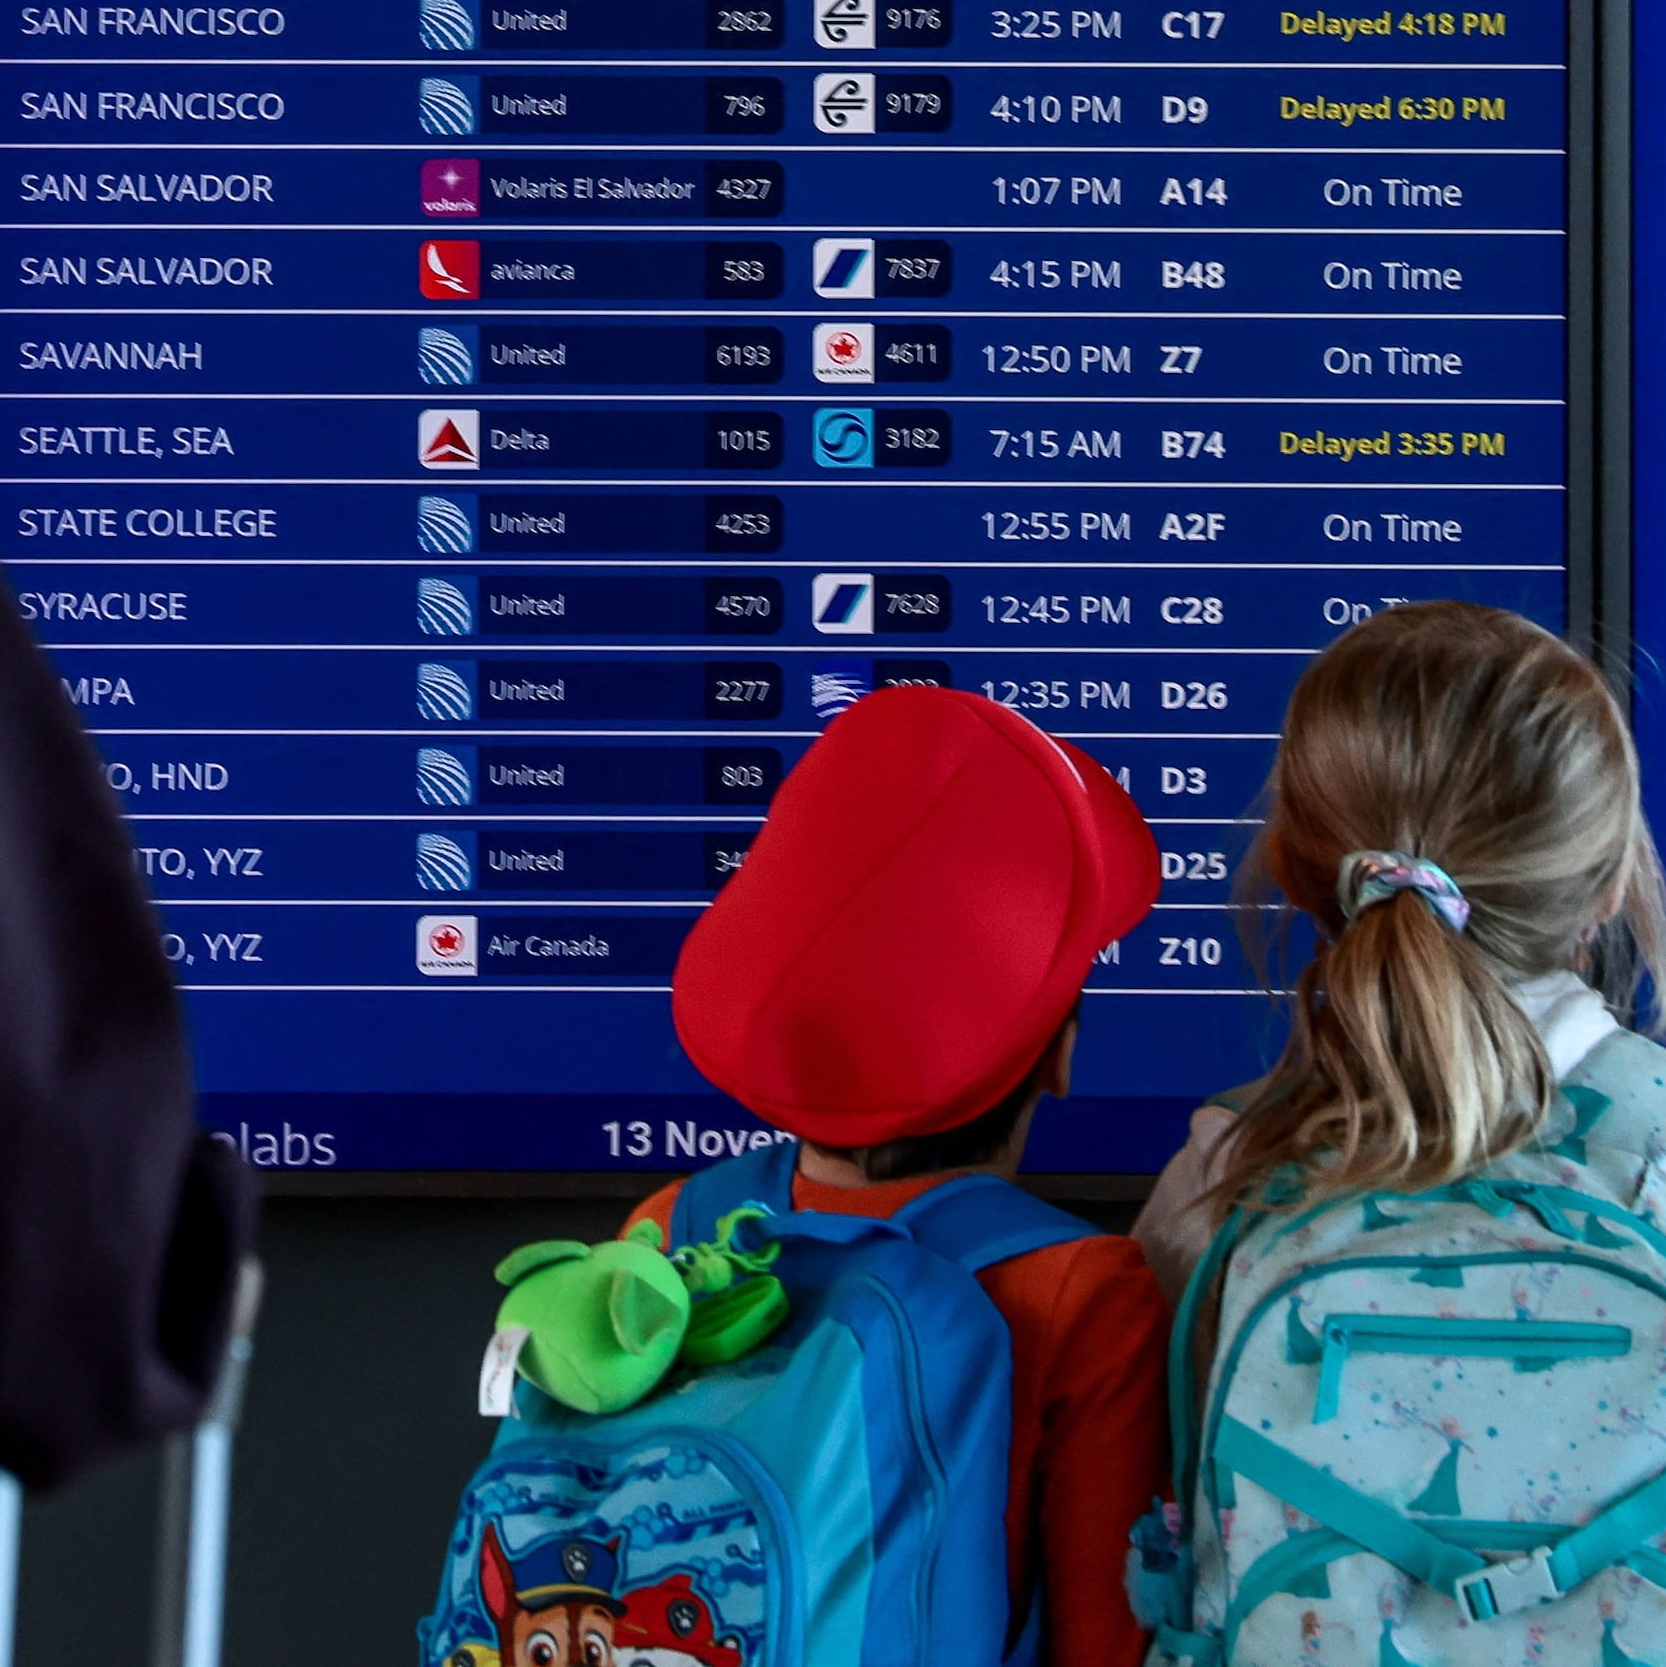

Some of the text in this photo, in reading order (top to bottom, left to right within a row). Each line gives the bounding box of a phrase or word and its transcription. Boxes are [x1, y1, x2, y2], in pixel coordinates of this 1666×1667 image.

[21, 174, 274, 202] SAN SALVADOR
[490, 177, 695, 199] Volaris El Salvador
[993, 177, 1121, 205] 1:07 PM
[1159, 178, 1228, 205] A14
[1324, 178, 1462, 206] On Time
[19, 427, 235, 459] SEATTLE, SEA
[491, 428, 549, 450] Delta
[989, 430, 1121, 458] 7:15 AM
[1162, 431, 1226, 458] B74
[1280, 432, 1505, 462] Delayed 3:35 PM
[602, 1121, 652, 1156] 13
